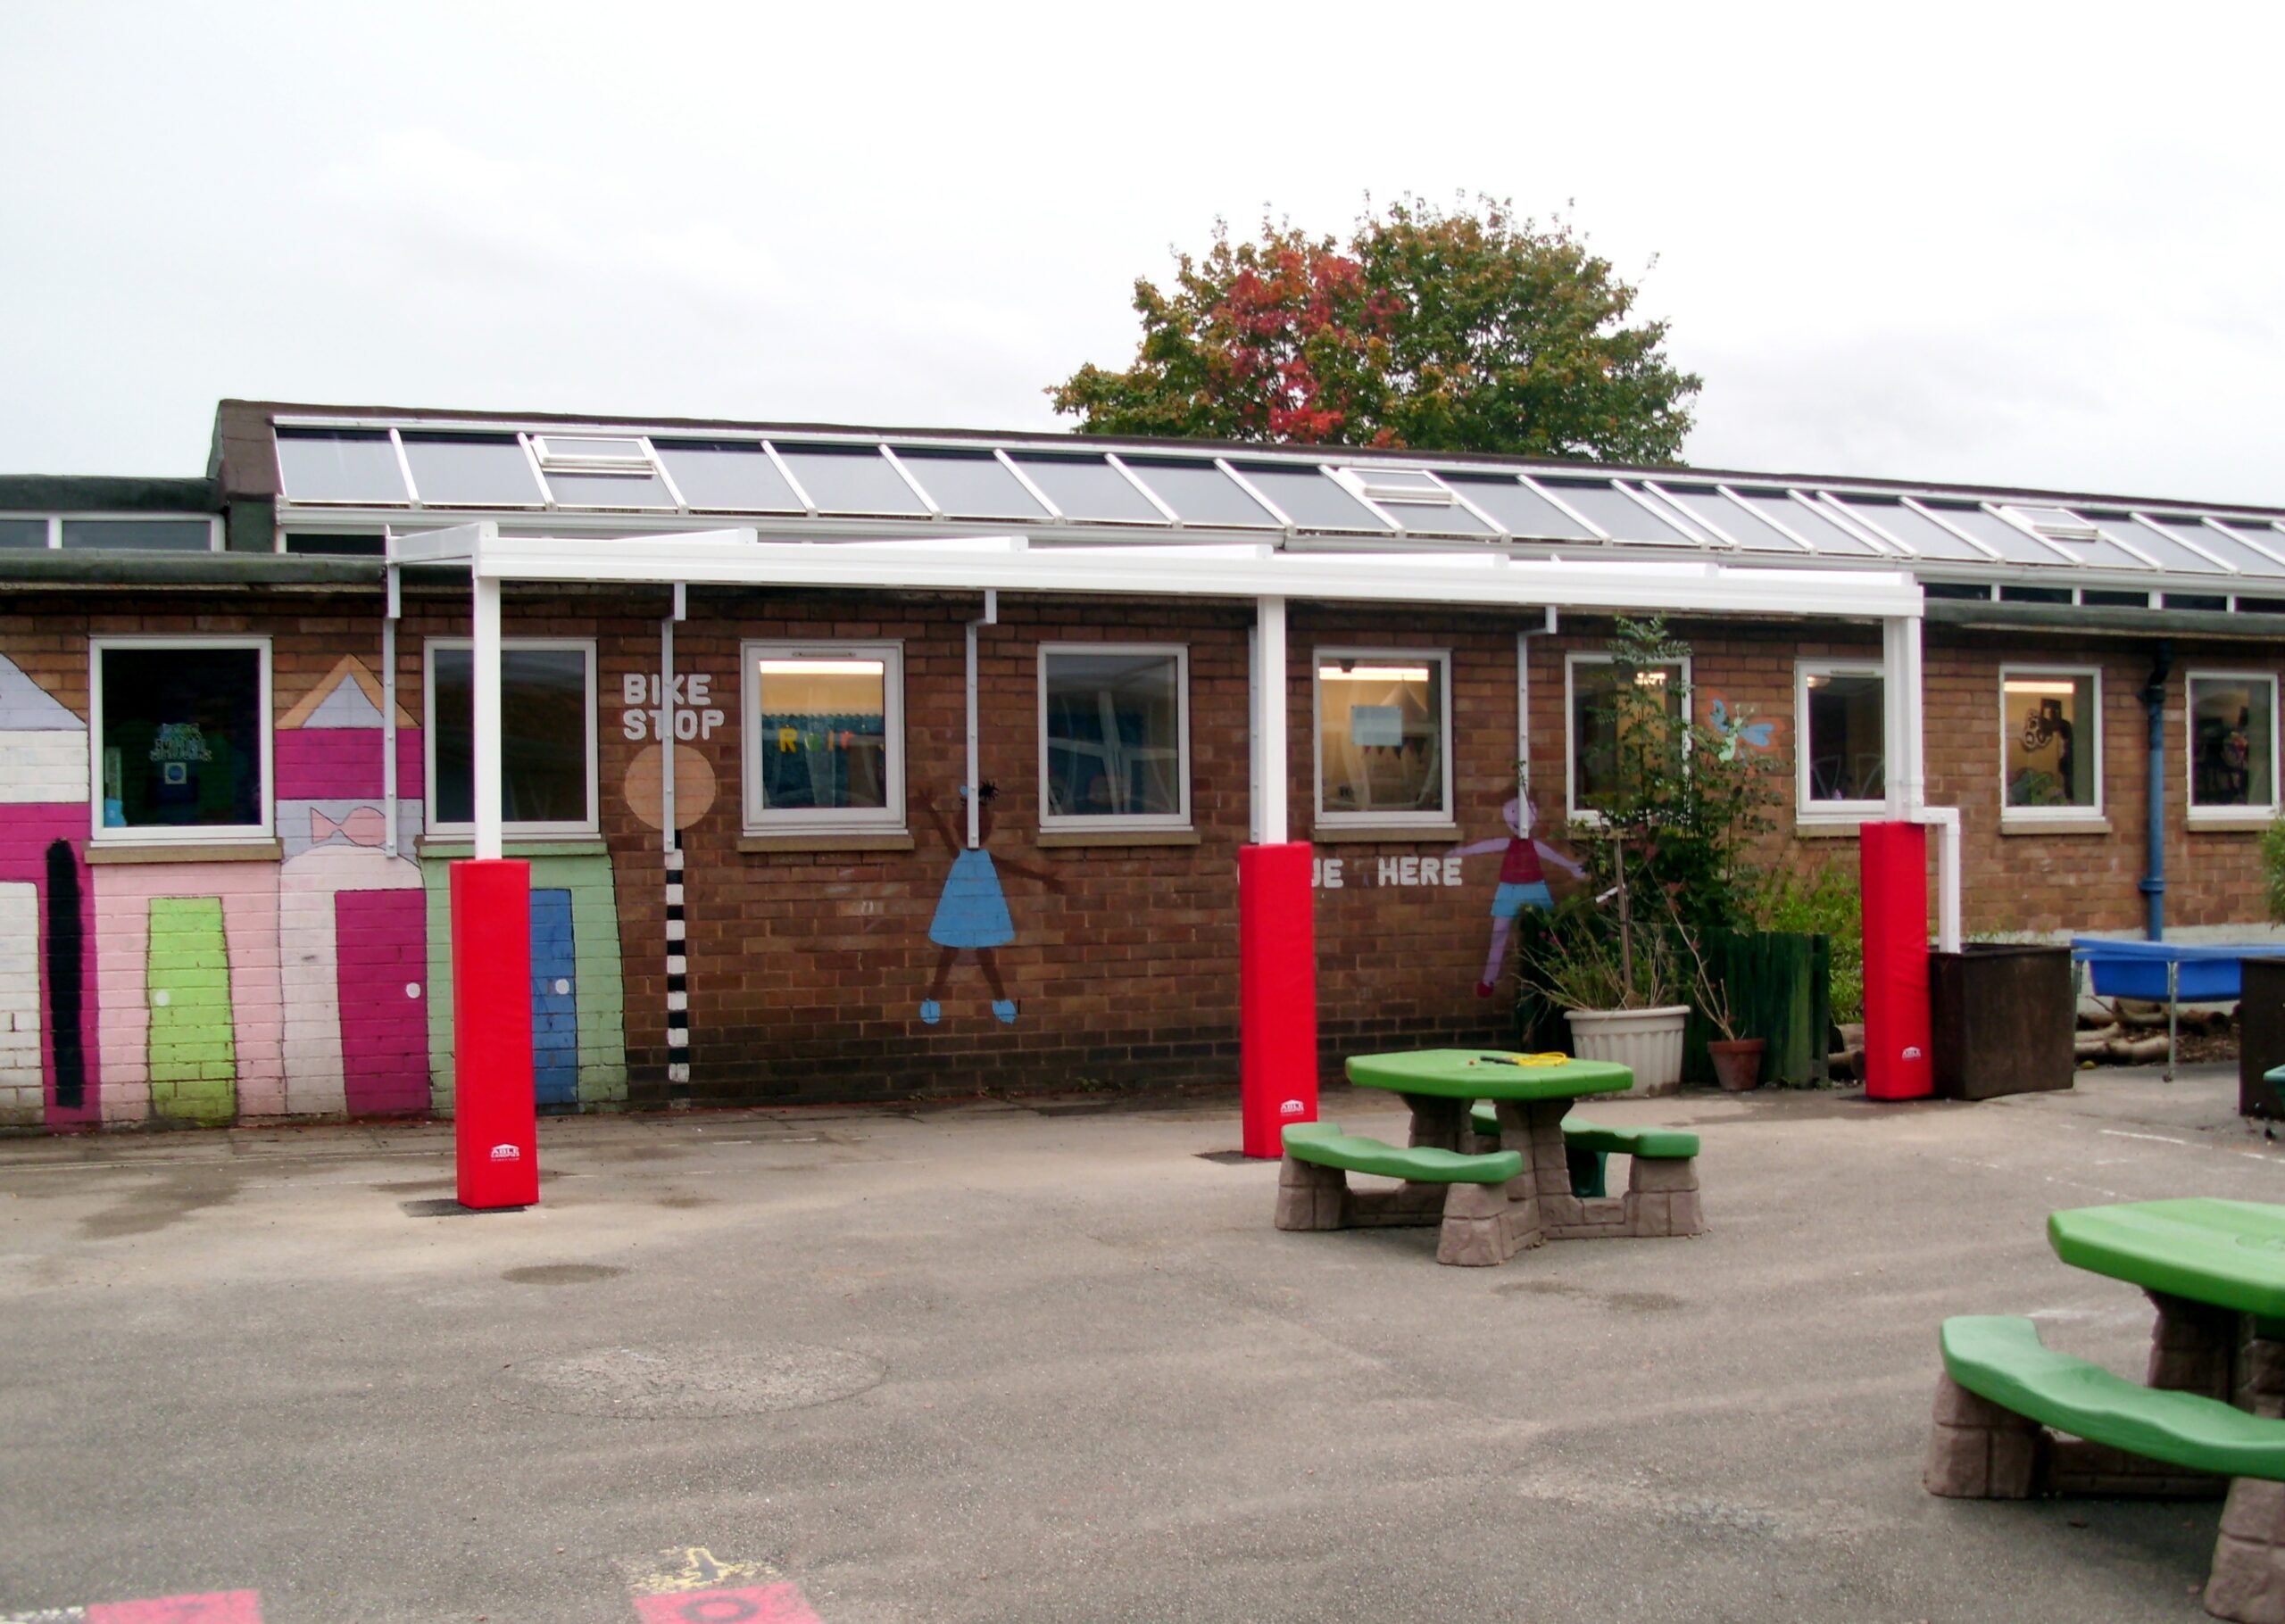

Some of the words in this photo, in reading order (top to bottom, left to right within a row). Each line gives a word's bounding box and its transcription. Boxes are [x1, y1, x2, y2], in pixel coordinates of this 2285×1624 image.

[623, 673, 712, 706] BIKE
[623, 708, 725, 741] STOP
[1377, 856, 1463, 887] HERE
